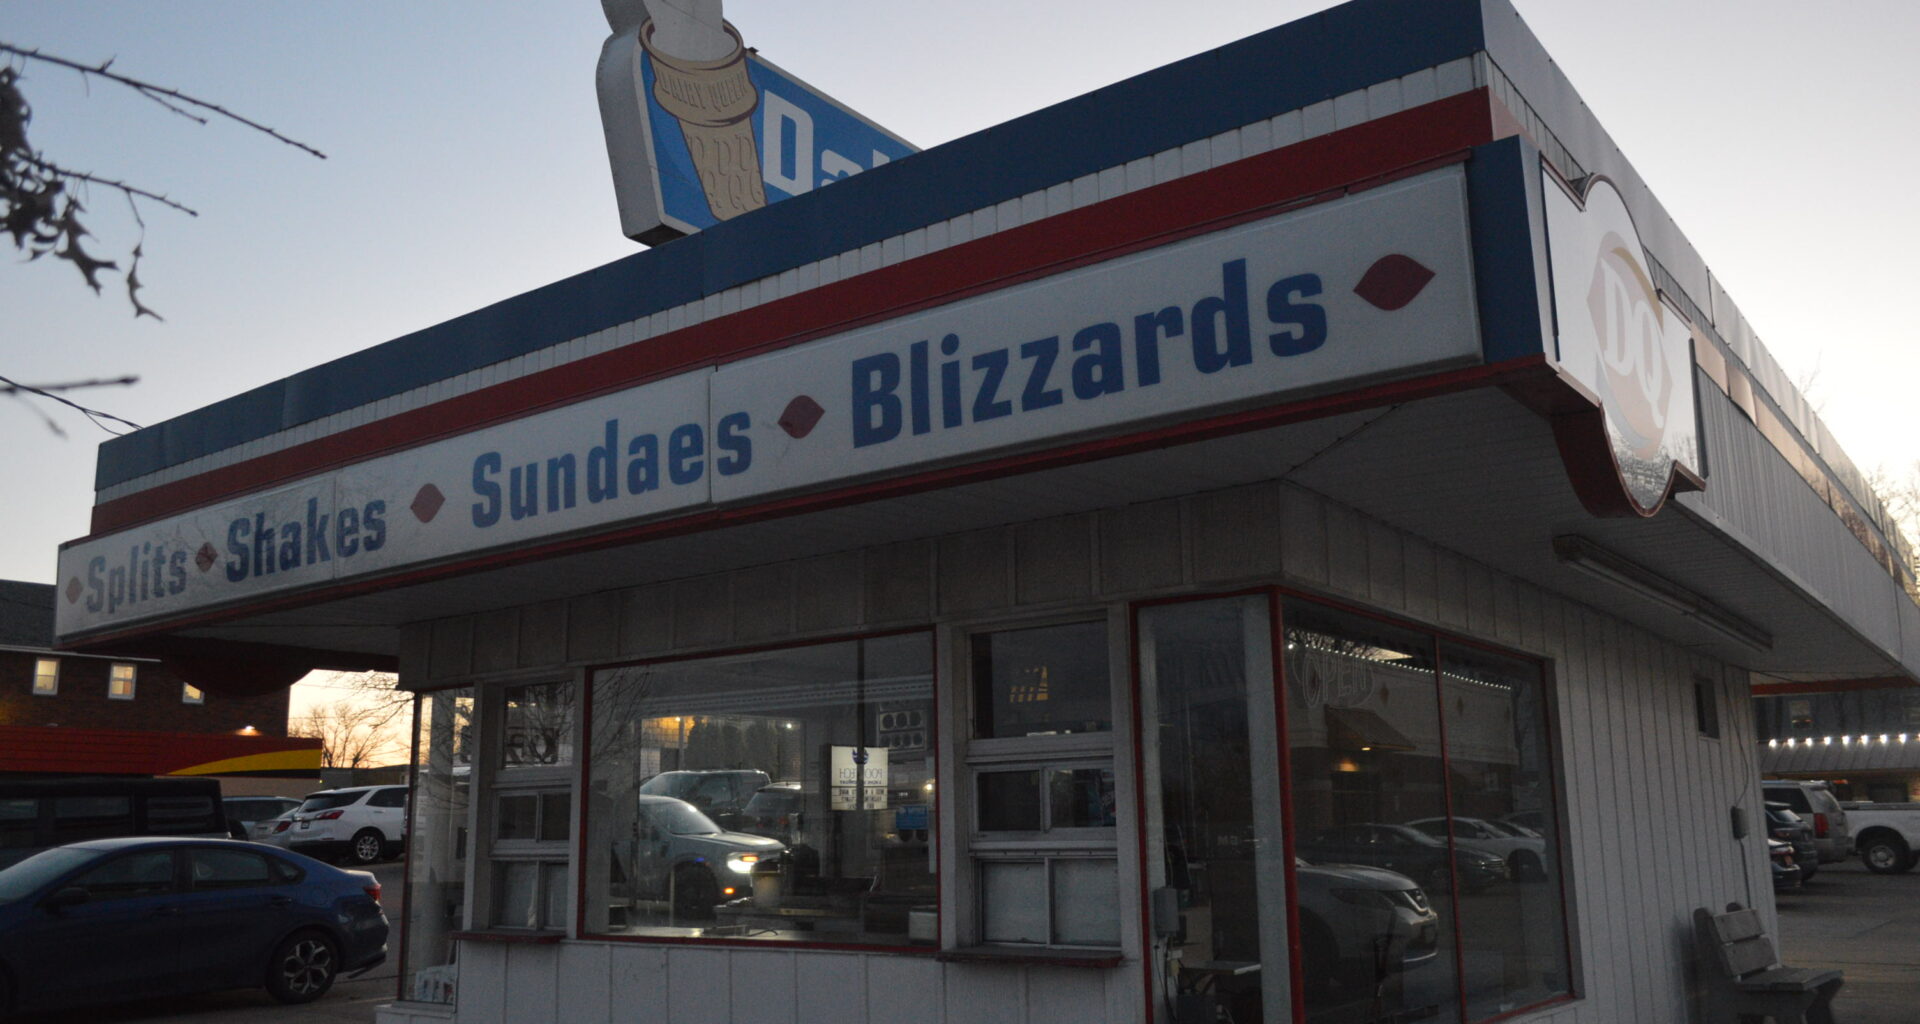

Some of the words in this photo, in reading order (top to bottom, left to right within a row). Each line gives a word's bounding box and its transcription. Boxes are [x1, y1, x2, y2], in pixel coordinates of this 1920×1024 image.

[852, 257, 1328, 449] Blizzards
[1600, 256, 1666, 430] DQ
[471, 411, 752, 528] Sundaes
[87, 541, 188, 614] Splits
[226, 496, 387, 583] Shakes
